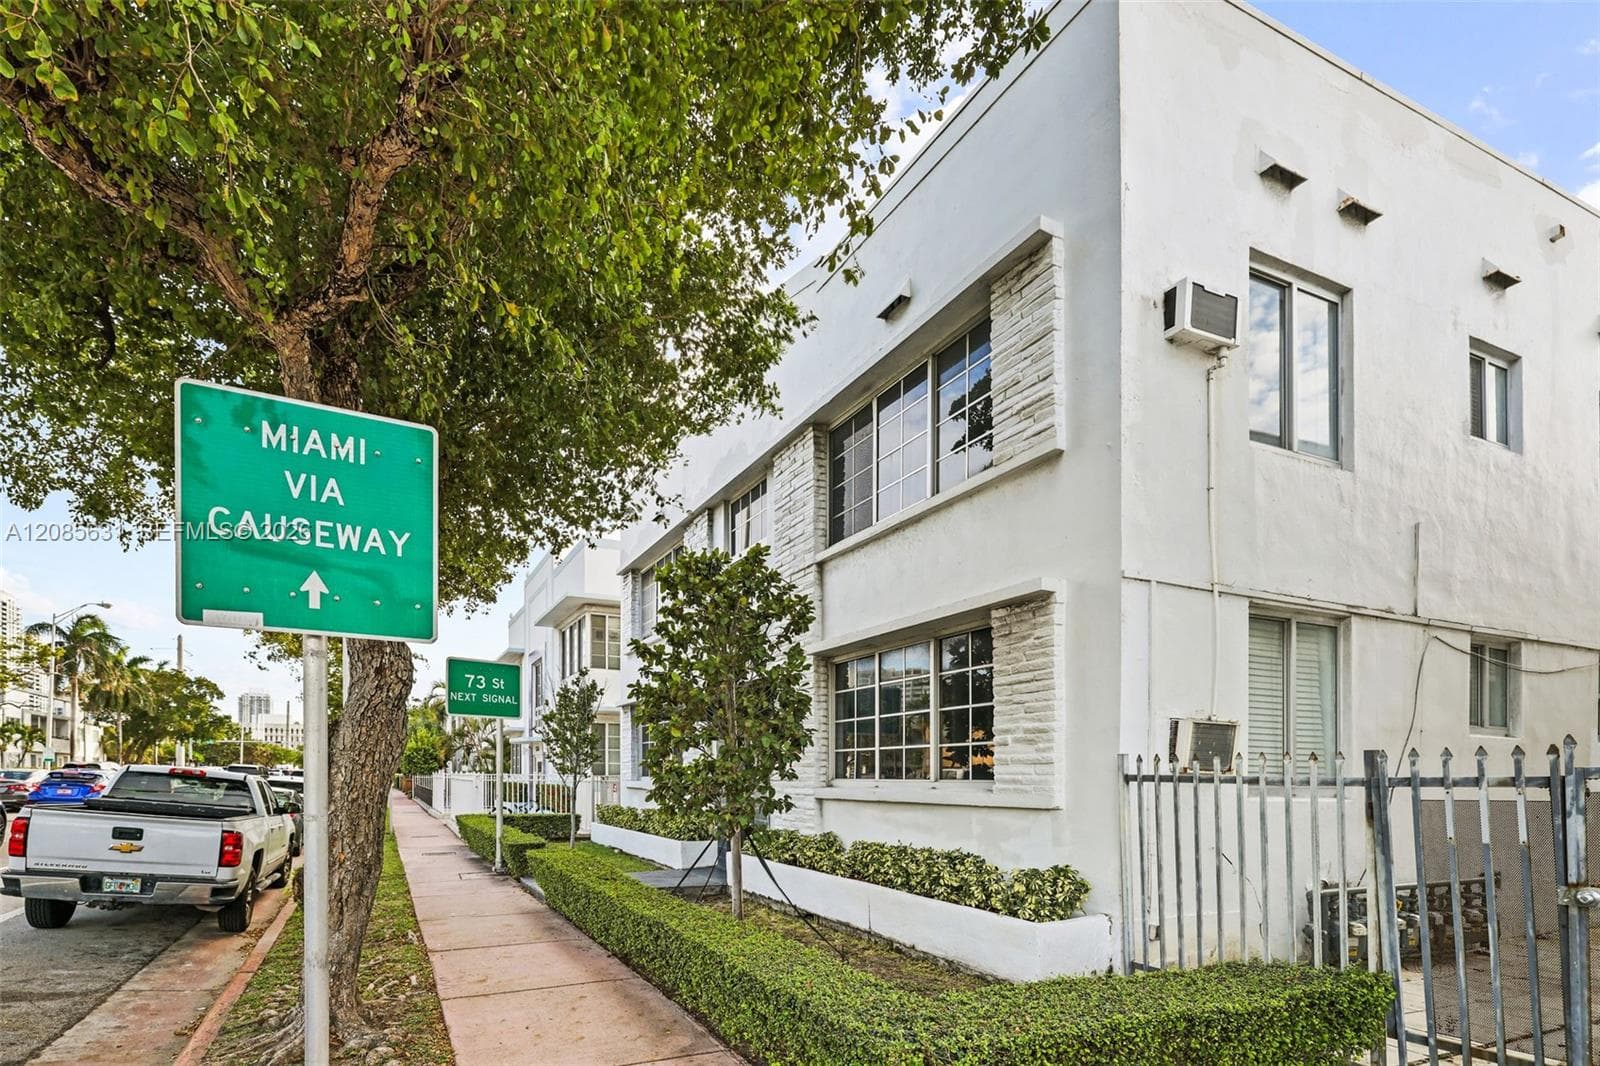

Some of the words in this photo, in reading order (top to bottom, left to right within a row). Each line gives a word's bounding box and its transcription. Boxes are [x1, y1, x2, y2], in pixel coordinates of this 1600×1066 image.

[260, 420, 367, 465] MIAMI
[284, 470, 345, 507] VIA
[208, 506, 411, 557] CAUSEWAY
[450, 691, 477, 702] NEXT
[482, 693, 518, 705] SIGNAL
[464, 674, 486, 689] 73
[492, 677, 505, 690] St
